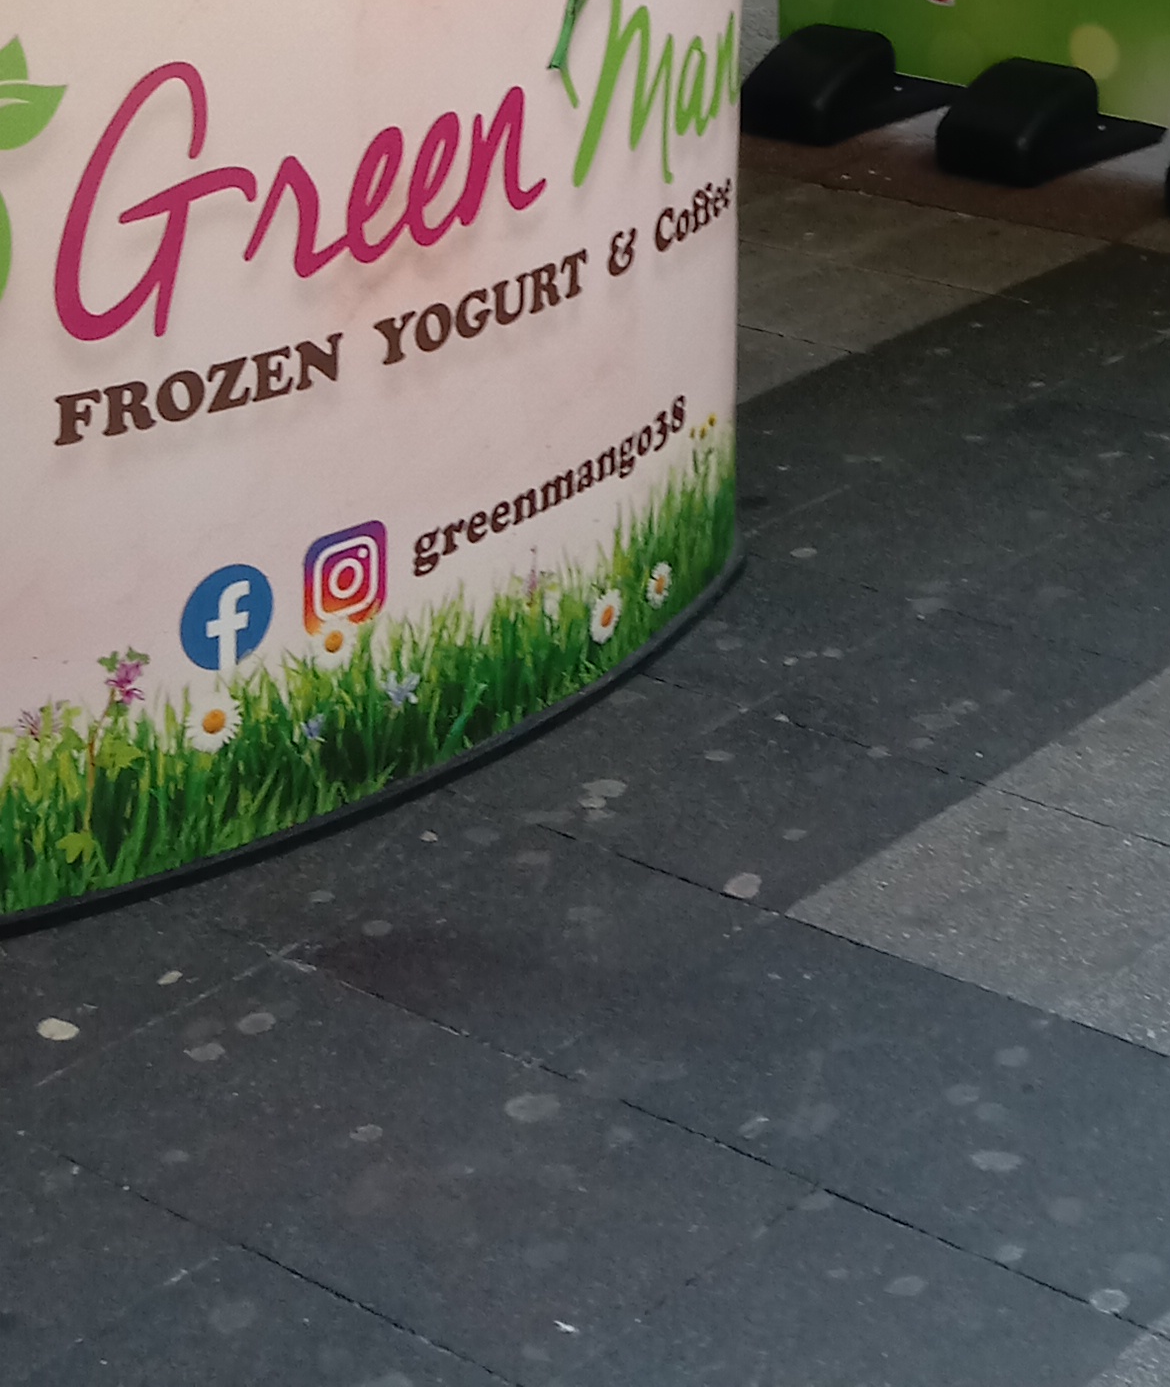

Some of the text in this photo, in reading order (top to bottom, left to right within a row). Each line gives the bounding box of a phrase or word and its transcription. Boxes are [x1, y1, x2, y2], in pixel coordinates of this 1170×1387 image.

[54, 62, 547, 341] Green
[53, 333, 344, 447] FROZEN
[373, 249, 589, 366] YOGURT
[608, 226, 636, 277] &
[412, 394, 687, 577] greenmango38
